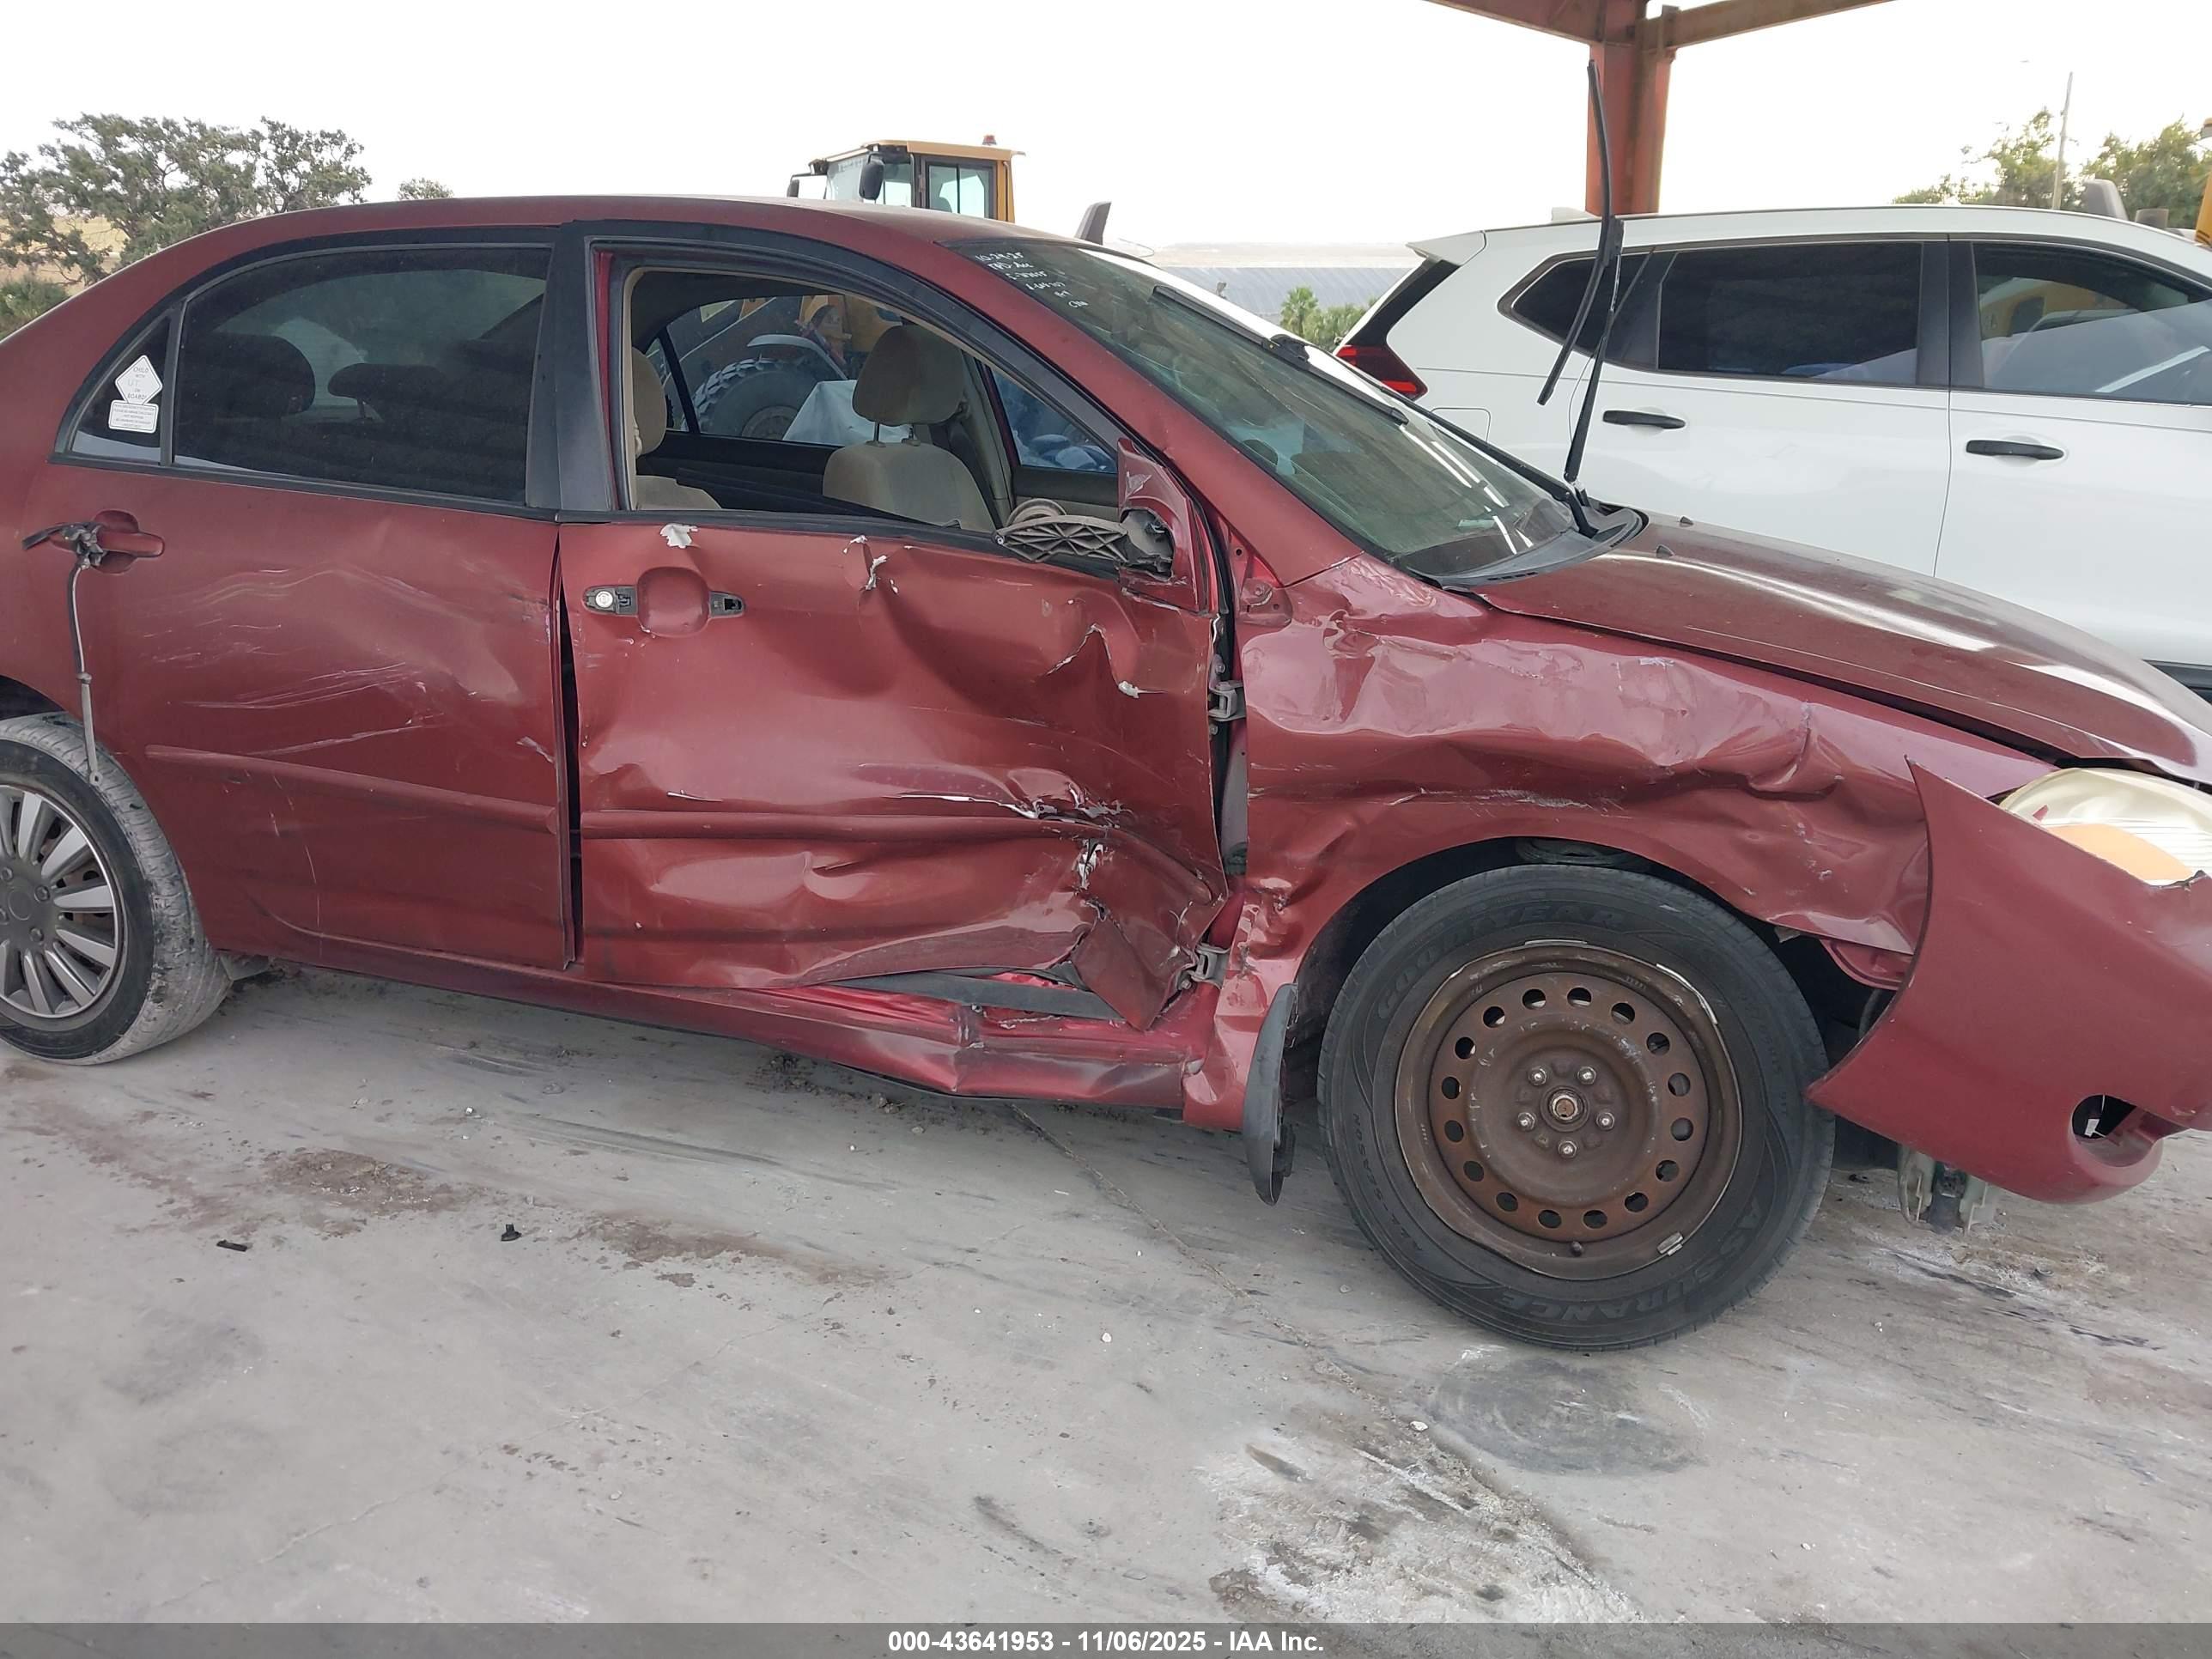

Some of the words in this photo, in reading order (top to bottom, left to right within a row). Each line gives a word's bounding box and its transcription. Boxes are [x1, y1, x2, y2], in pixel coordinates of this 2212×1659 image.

[1379, 904, 1626, 1018] GOODYEAR
[1352, 1112, 1425, 1251] ALL-SEASON
[1496, 1194, 1771, 1321] ASSURANCE
